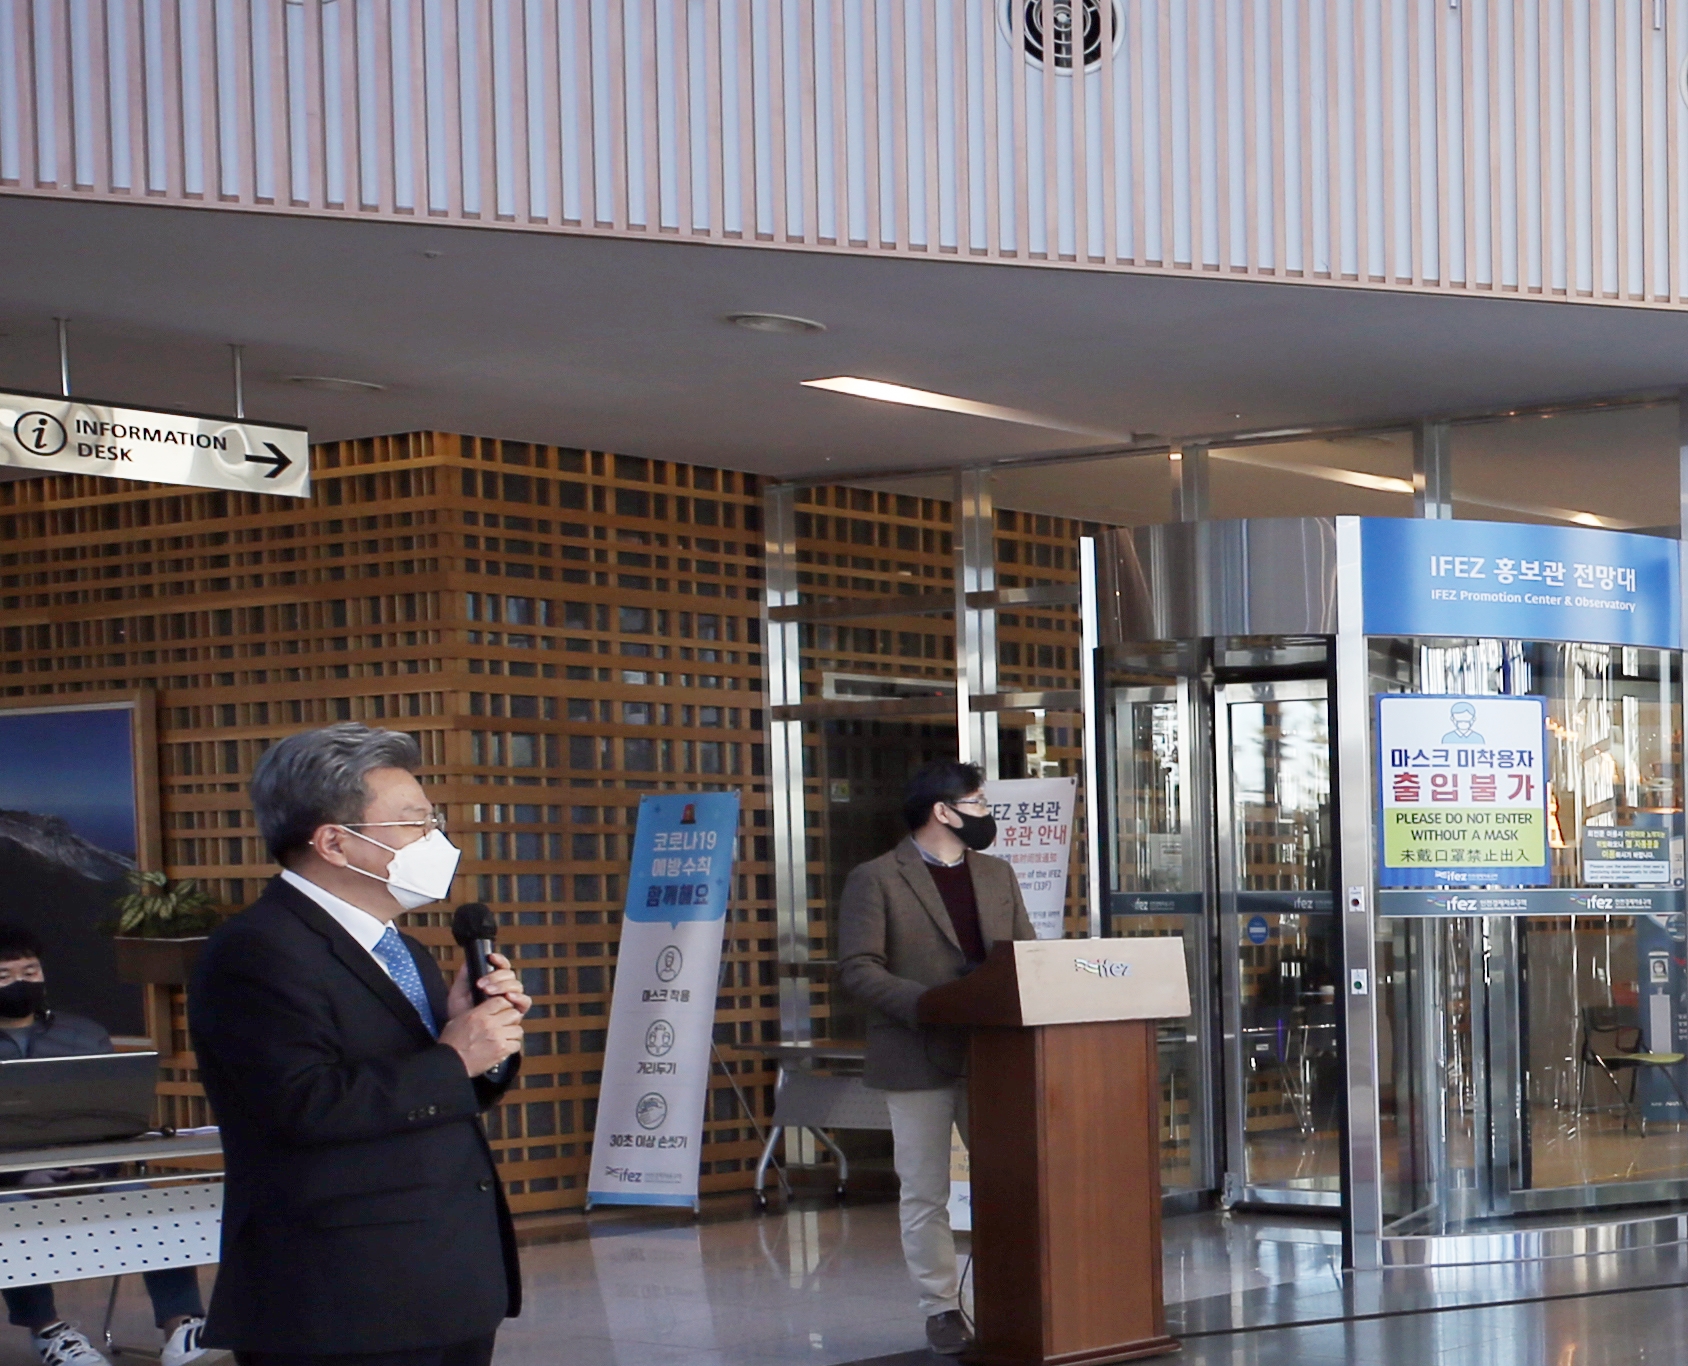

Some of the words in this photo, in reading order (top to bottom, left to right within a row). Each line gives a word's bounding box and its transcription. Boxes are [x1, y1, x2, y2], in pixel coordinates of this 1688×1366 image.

[75, 419, 227, 451] INFORMATION
[77, 443, 133, 462] DESK
[1430, 556, 1486, 578] IFEZ
[1493, 558, 1566, 587] 홍보관
[1573, 563, 1636, 592] 전망대
[1431, 589, 1457, 600] IFEZ
[1460, 590, 1521, 603] Promotion
[1525, 593, 1561, 606] Center
[1564, 596, 1573, 606] &
[1575, 596, 1636, 613] Observatory
[1391, 749, 1451, 768] 마스크
[1457, 749, 1534, 768] 미착용자
[1393, 772, 1534, 802] 출입불가
[1016, 802, 1061, 823] 홍보관
[1396, 813, 1441, 824] PLEASE
[1445, 813, 1463, 824] DO
[1466, 813, 1491, 824] NOT
[1495, 813, 1532, 824] ENTER
[653, 831, 717, 852] 코로나19
[1003, 826, 1033, 847] 휴관
[1038, 825, 1067, 845] 안내
[1411, 829, 1467, 841] WITHOUT
[1472, 830, 1480, 841] A
[1484, 829, 1518, 841] MASK
[1400, 848, 1530, 863] 未戴口罩禁止出入
[651, 856, 712, 877] 예방수칙
[646, 884, 709, 907] 함께해요
[1446, 895, 1478, 911] ifez
[1587, 895, 1613, 909] ifez
[641, 989, 668, 1003] 마스크
[669, 989, 691, 1003] 착용
[636, 1062, 676, 1075] 거리두기
[609, 1134, 633, 1148] 30초
[635, 1135, 656, 1148] 이상
[658, 1135, 687, 1148] 손씻기
[619, 1168, 642, 1182] ifez
